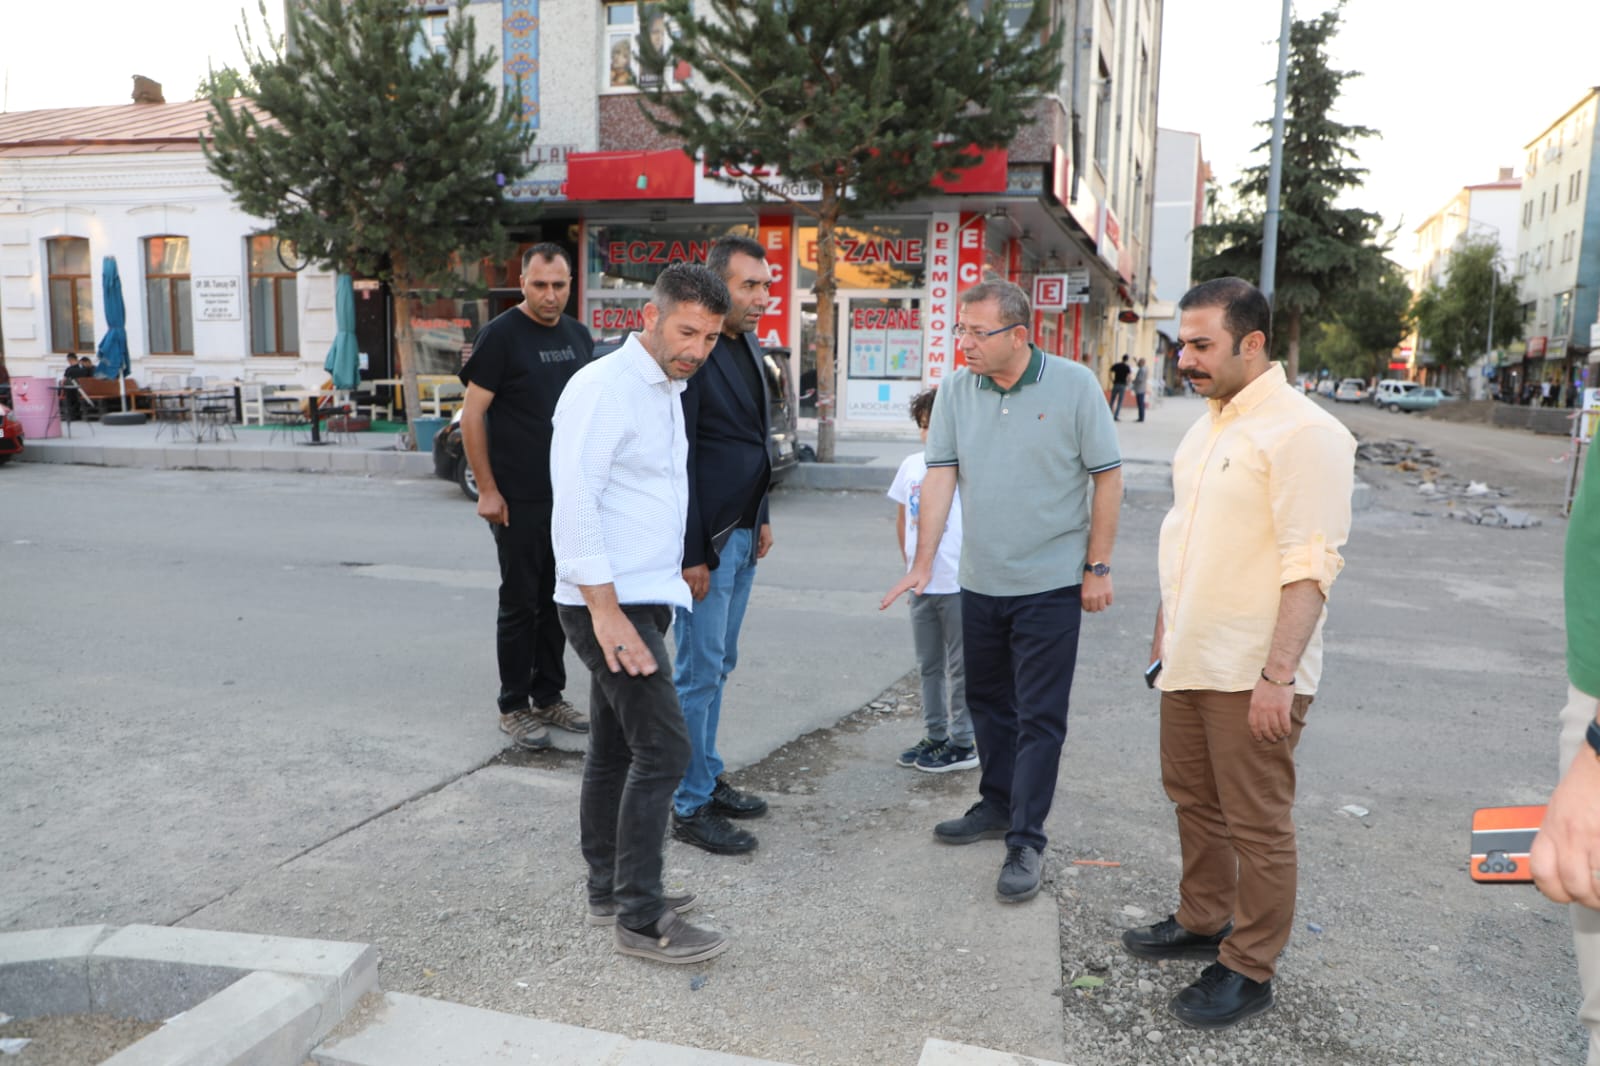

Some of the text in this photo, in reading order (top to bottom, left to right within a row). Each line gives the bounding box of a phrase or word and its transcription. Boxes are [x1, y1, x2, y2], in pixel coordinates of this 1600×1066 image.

[608, 240, 719, 264] ECZAN
[806, 239, 923, 263] EZANE
[764, 230, 783, 347] ECZA
[1042, 283, 1057, 300] E
[592, 308, 645, 330] ECZAN
[853, 308, 920, 330] ECZANE
